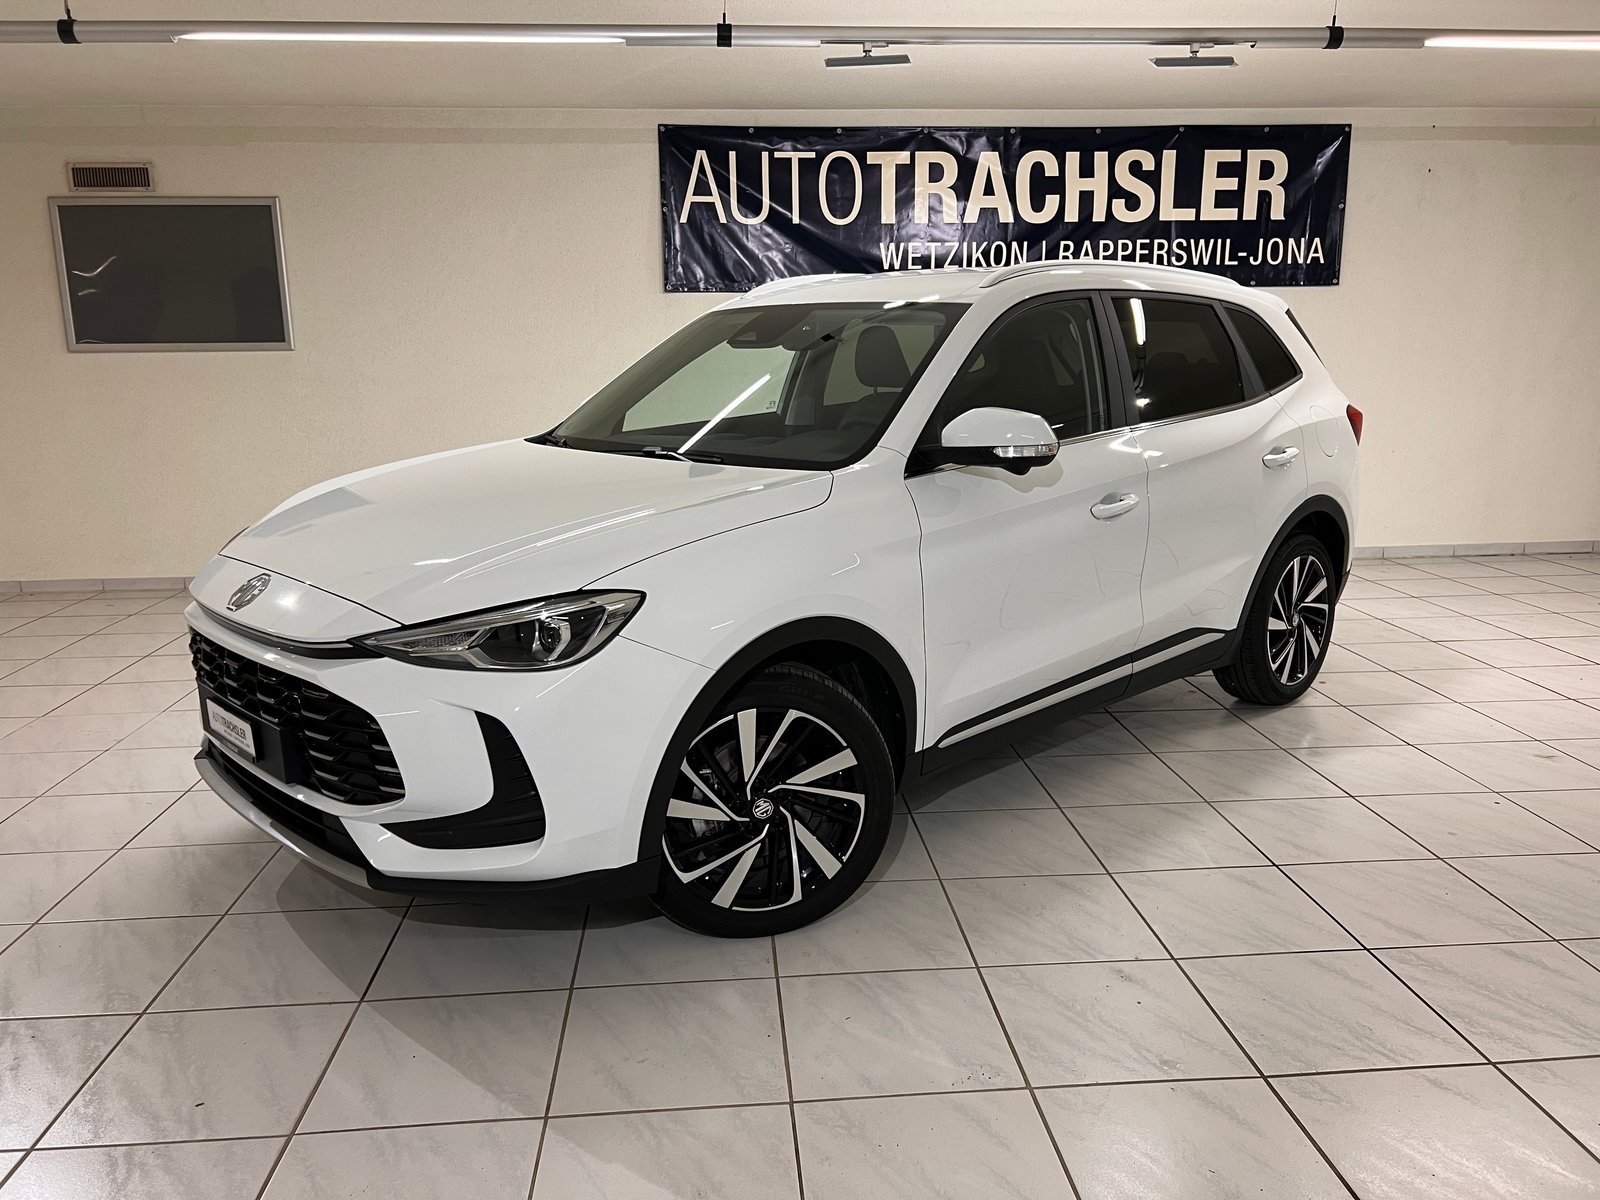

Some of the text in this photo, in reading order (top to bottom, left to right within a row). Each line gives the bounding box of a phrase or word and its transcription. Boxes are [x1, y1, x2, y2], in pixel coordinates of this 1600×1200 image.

[679, 148, 1288, 226] AUTOTRACHSLER
[879, 240, 1028, 270] WETZIKON
[1058, 237, 1325, 266] RAPPERSWIL-JONA
